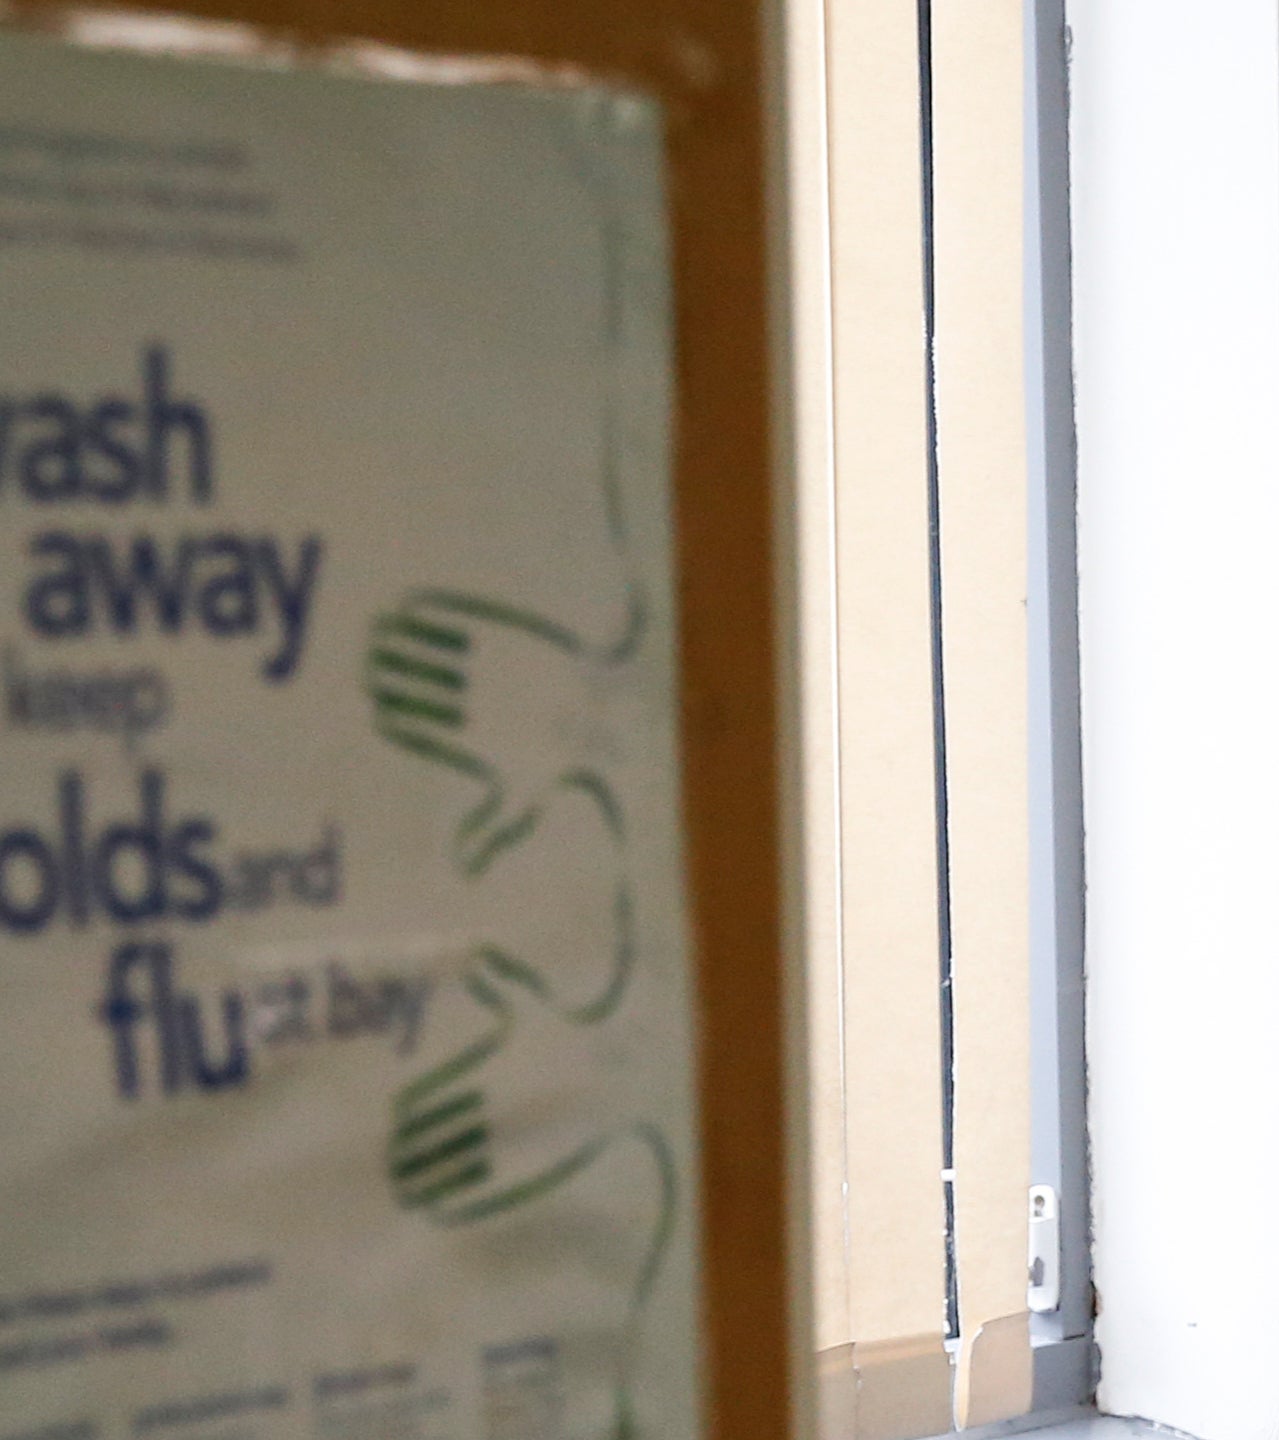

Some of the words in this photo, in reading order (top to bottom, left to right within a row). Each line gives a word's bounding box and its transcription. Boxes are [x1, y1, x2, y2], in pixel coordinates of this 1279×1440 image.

[0, 338, 214, 505] ash
[25, 528, 324, 687] away
[0, 767, 223, 936] olds
[96, 940, 249, 1101] flu
